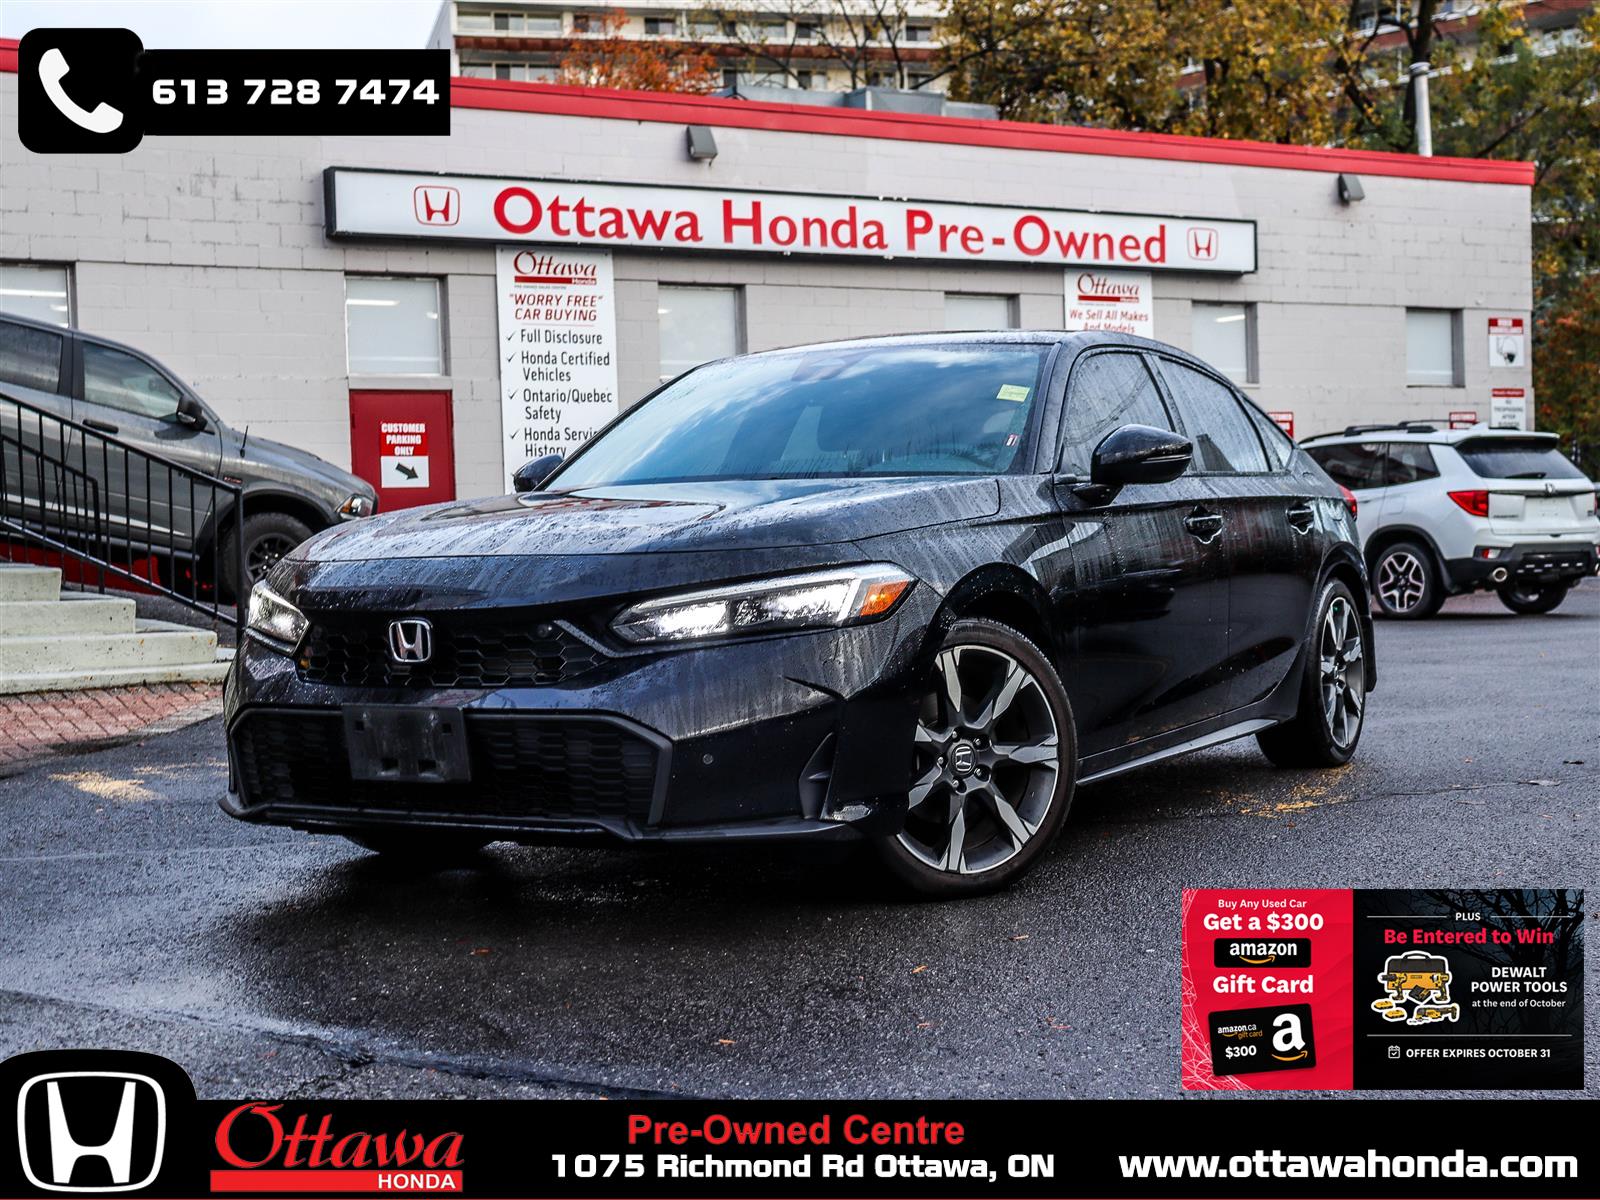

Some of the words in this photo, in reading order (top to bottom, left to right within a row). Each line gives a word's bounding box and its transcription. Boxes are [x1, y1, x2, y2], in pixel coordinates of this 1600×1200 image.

[493, 187, 703, 243] Ottawa
[722, 199, 888, 251] Honda
[905, 208, 1167, 264] Pre-Owned
[513, 250, 597, 276] Ottawa
[1077, 272, 1139, 295] Ottawa
[515, 308, 541, 320] CAR
[545, 309, 597, 322] BUYING
[1070, 309, 1083, 319] We
[1086, 309, 1102, 320] Sell
[1105, 310, 1117, 320] All
[1121, 311, 1149, 321] Makes
[521, 329, 541, 343] Full
[545, 329, 603, 344] Disclosure
[521, 350, 557, 365] Honda
[561, 351, 610, 366] Certified
[523, 367, 571, 381] Vehicles
[523, 388, 612, 405] Ontario/Quebec
[525, 406, 561, 423] Safety
[381, 423, 426, 433] CUSTOMER
[524, 427, 560, 441] Honda
[386, 434, 422, 445] PARKING
[394, 446, 414, 456] ONLY
